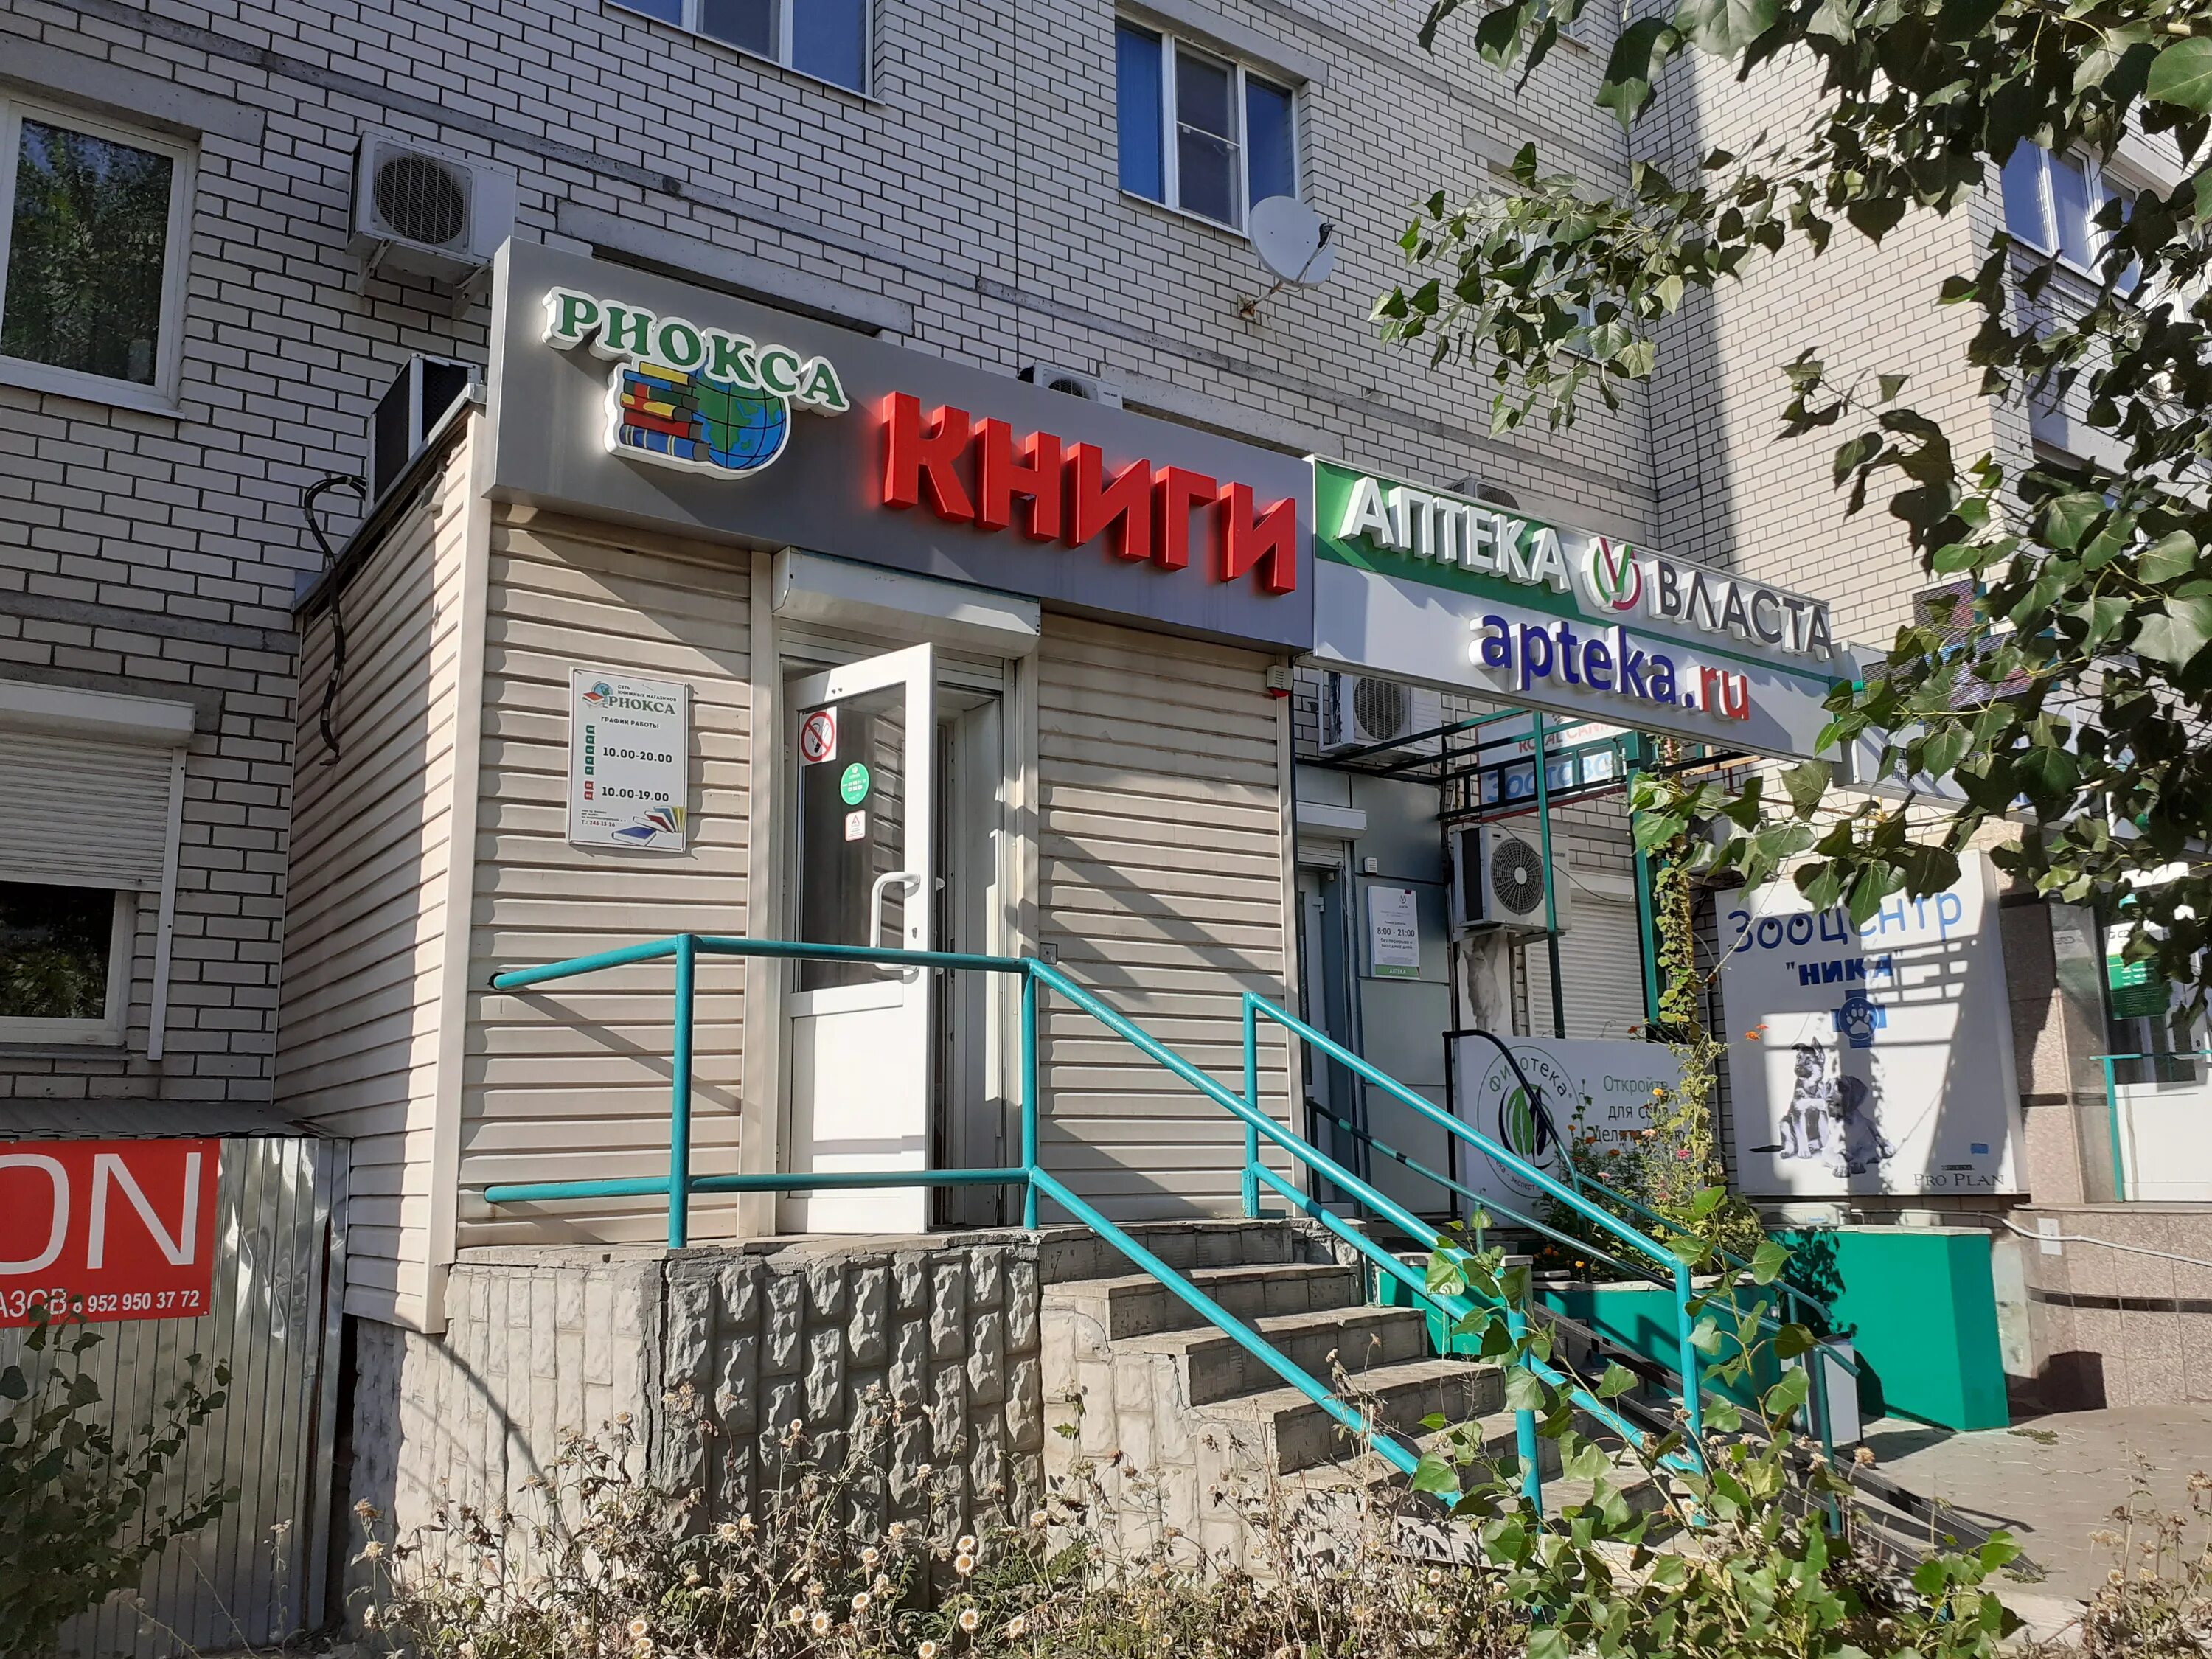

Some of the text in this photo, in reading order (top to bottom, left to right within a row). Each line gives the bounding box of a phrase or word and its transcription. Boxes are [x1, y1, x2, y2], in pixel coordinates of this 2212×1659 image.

[548, 288, 848, 412] РИОКСА
[883, 391, 1296, 595] КНИГИ
[1339, 476, 1835, 662] АПТЕКА ВЛАСТА
[1467, 614, 1749, 722] apteka.ru
[609, 695, 676, 714] РИОКСА
[646, 694, 677, 702] МАГАЗИНОВ
[601, 717, 659, 728] ГРАФИК РАБОТЫ
[1518, 734, 1563, 754] ROAL
[602, 747, 673, 763] 10.00-20.00
[602, 787, 669, 802] 10.00-19.00
[1377, 927, 1391, 935] 8:00
[1397, 929, 1415, 937] 21:00
[1489, 1057, 1568, 1097] Фиотека
[1608, 1105, 1633, 1120] для
[88, 1294, 117, 1313] 952
[122, 1293, 152, 1310] 950
[156, 1291, 176, 1309] 37
[181, 1290, 200, 1308] 72
